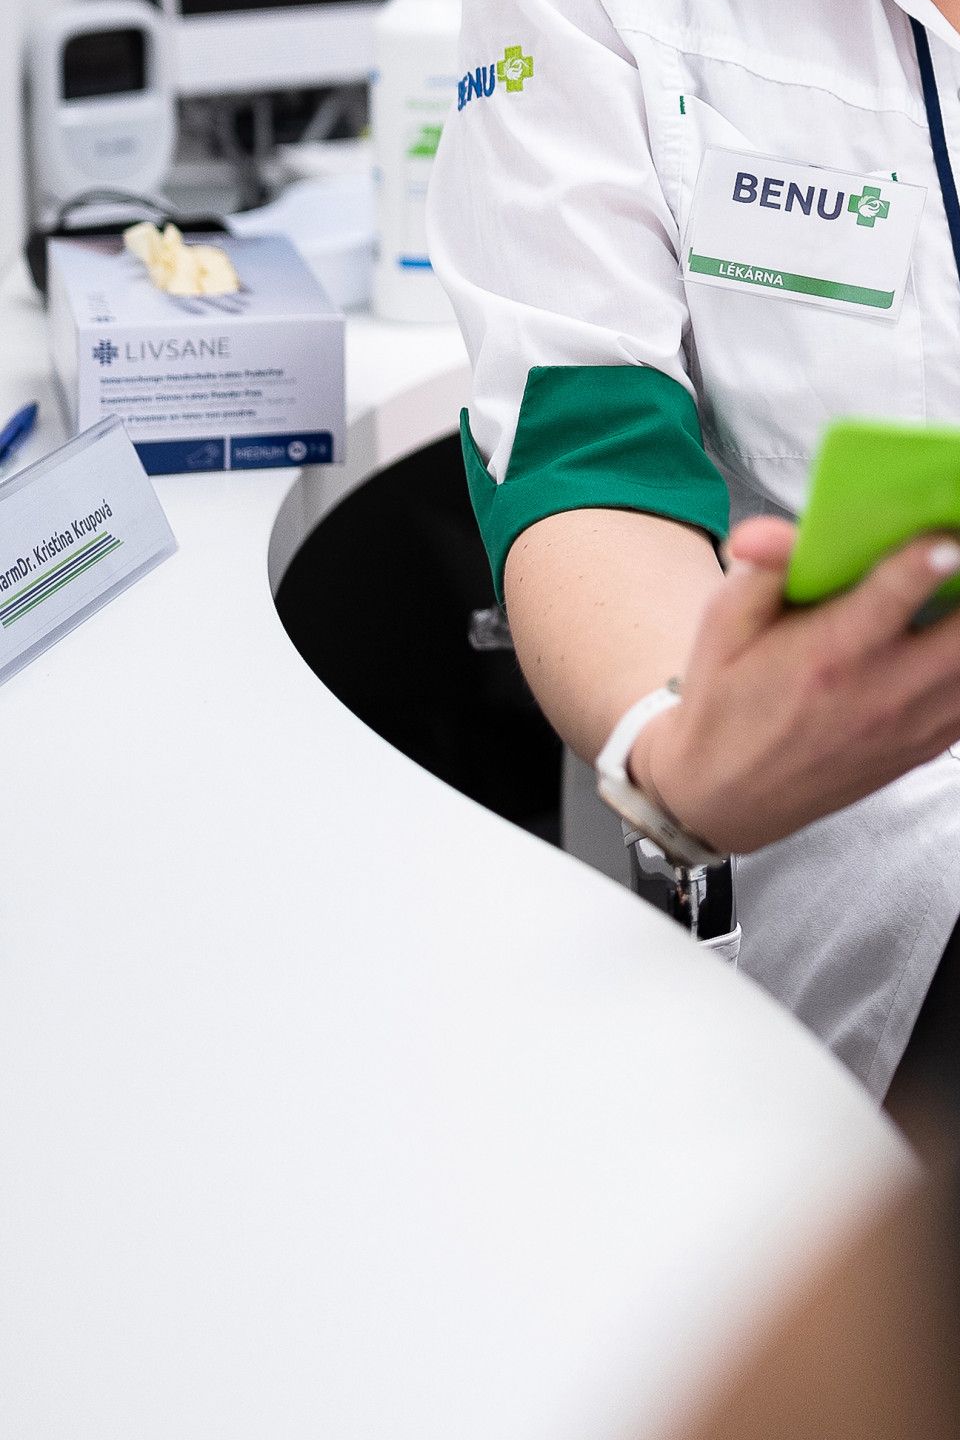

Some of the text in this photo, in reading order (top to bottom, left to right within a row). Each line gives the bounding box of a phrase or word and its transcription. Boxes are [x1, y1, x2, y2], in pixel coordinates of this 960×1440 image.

[732, 171, 845, 221] BENU
[718, 262, 784, 287] LÉKÁRNA
[125, 337, 230, 361] LIVSANE
[32, 531, 75, 566] Kristína
[70, 499, 113, 539] Krupová
